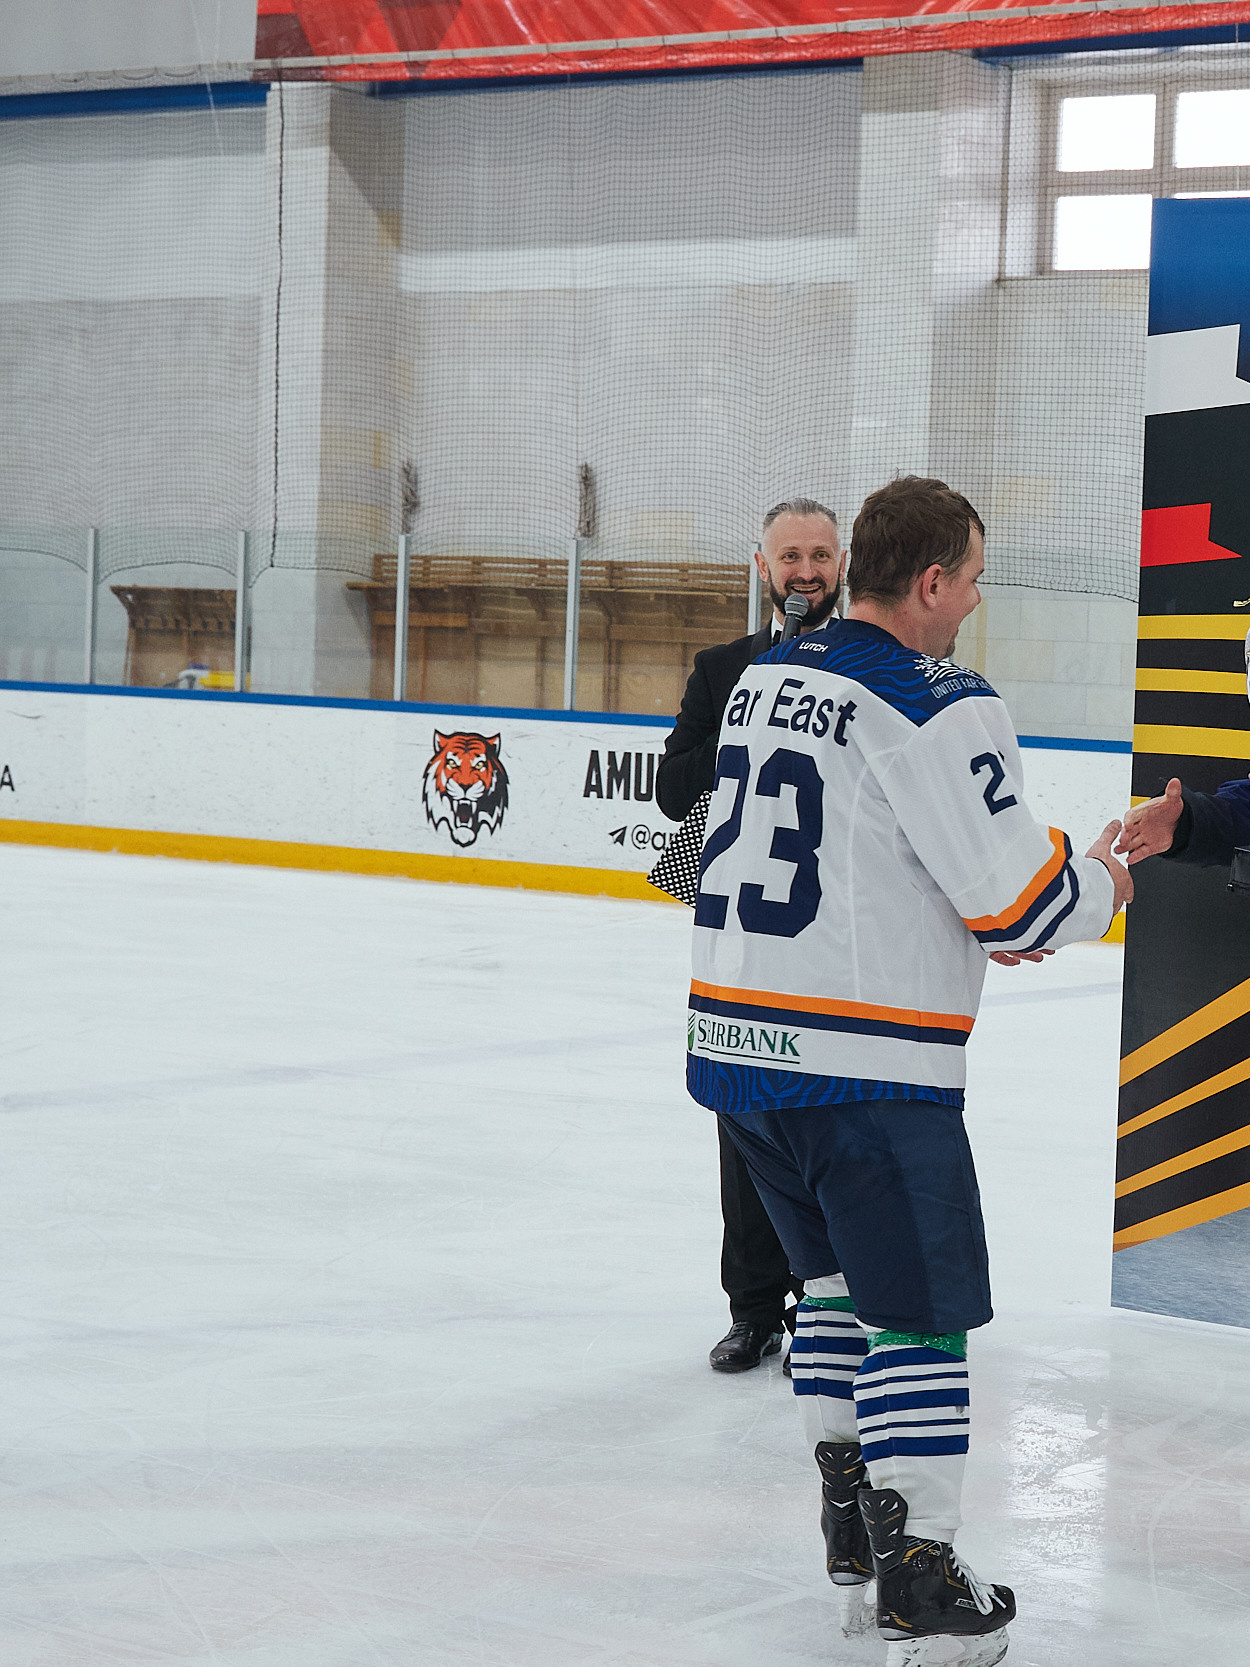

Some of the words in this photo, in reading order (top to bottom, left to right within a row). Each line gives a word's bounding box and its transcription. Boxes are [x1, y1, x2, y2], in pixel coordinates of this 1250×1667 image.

[799, 641, 829, 653] LUTCH
[767, 678, 858, 747] East
[930, 679, 962, 699] UNITED
[583, 749, 664, 802] AMU
[970, 750, 1018, 816] 2
[694, 744, 825, 938] 23
